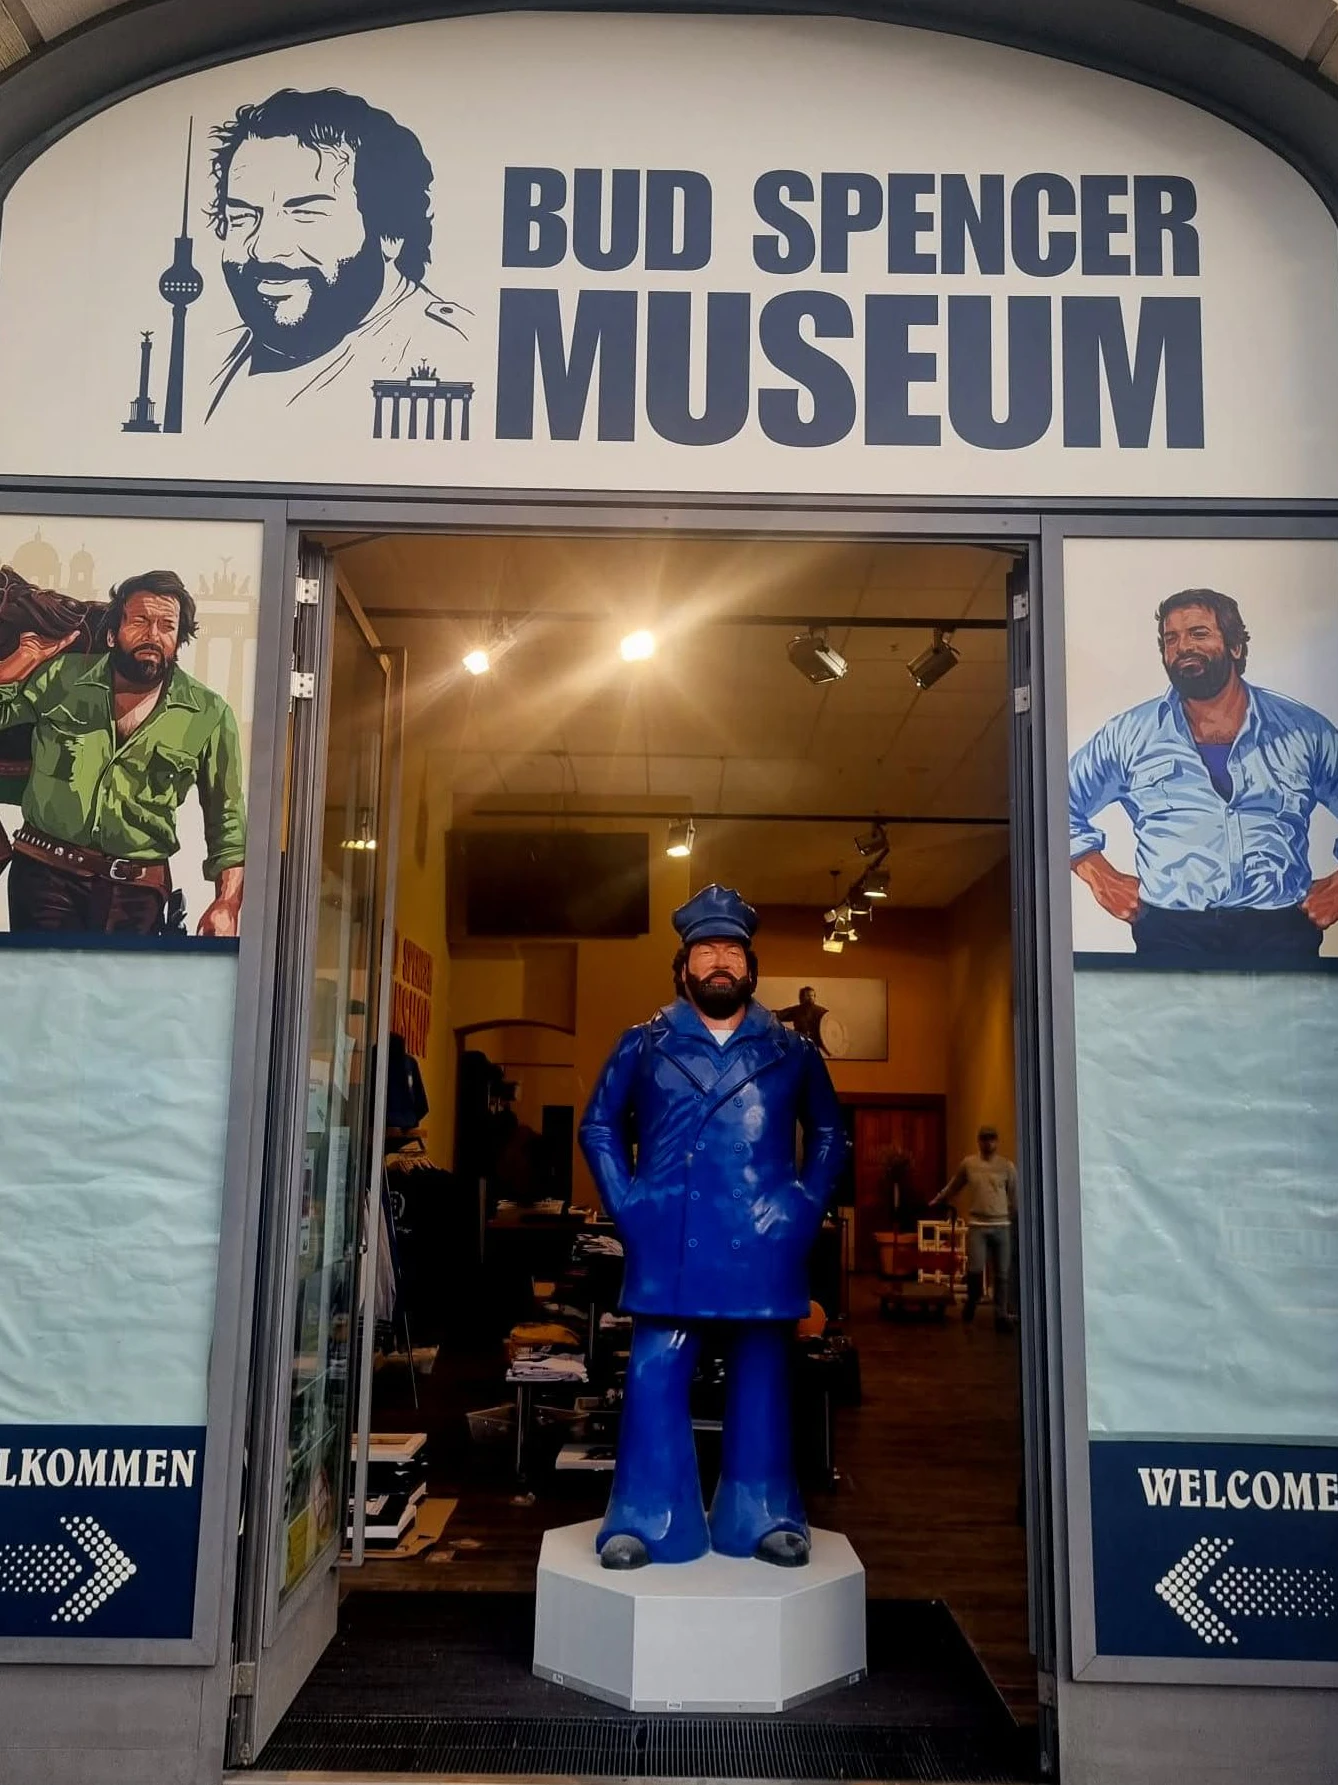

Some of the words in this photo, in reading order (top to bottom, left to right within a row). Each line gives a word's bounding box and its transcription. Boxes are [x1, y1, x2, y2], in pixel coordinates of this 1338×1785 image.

[502, 167, 712, 271] BUD
[753, 170, 1200, 277] SPENCER
[496, 288, 1204, 450] MUSEUM
[0, 1448, 196, 1487] LKOMMEN
[1138, 1468, 1338, 1511] WELCOME
